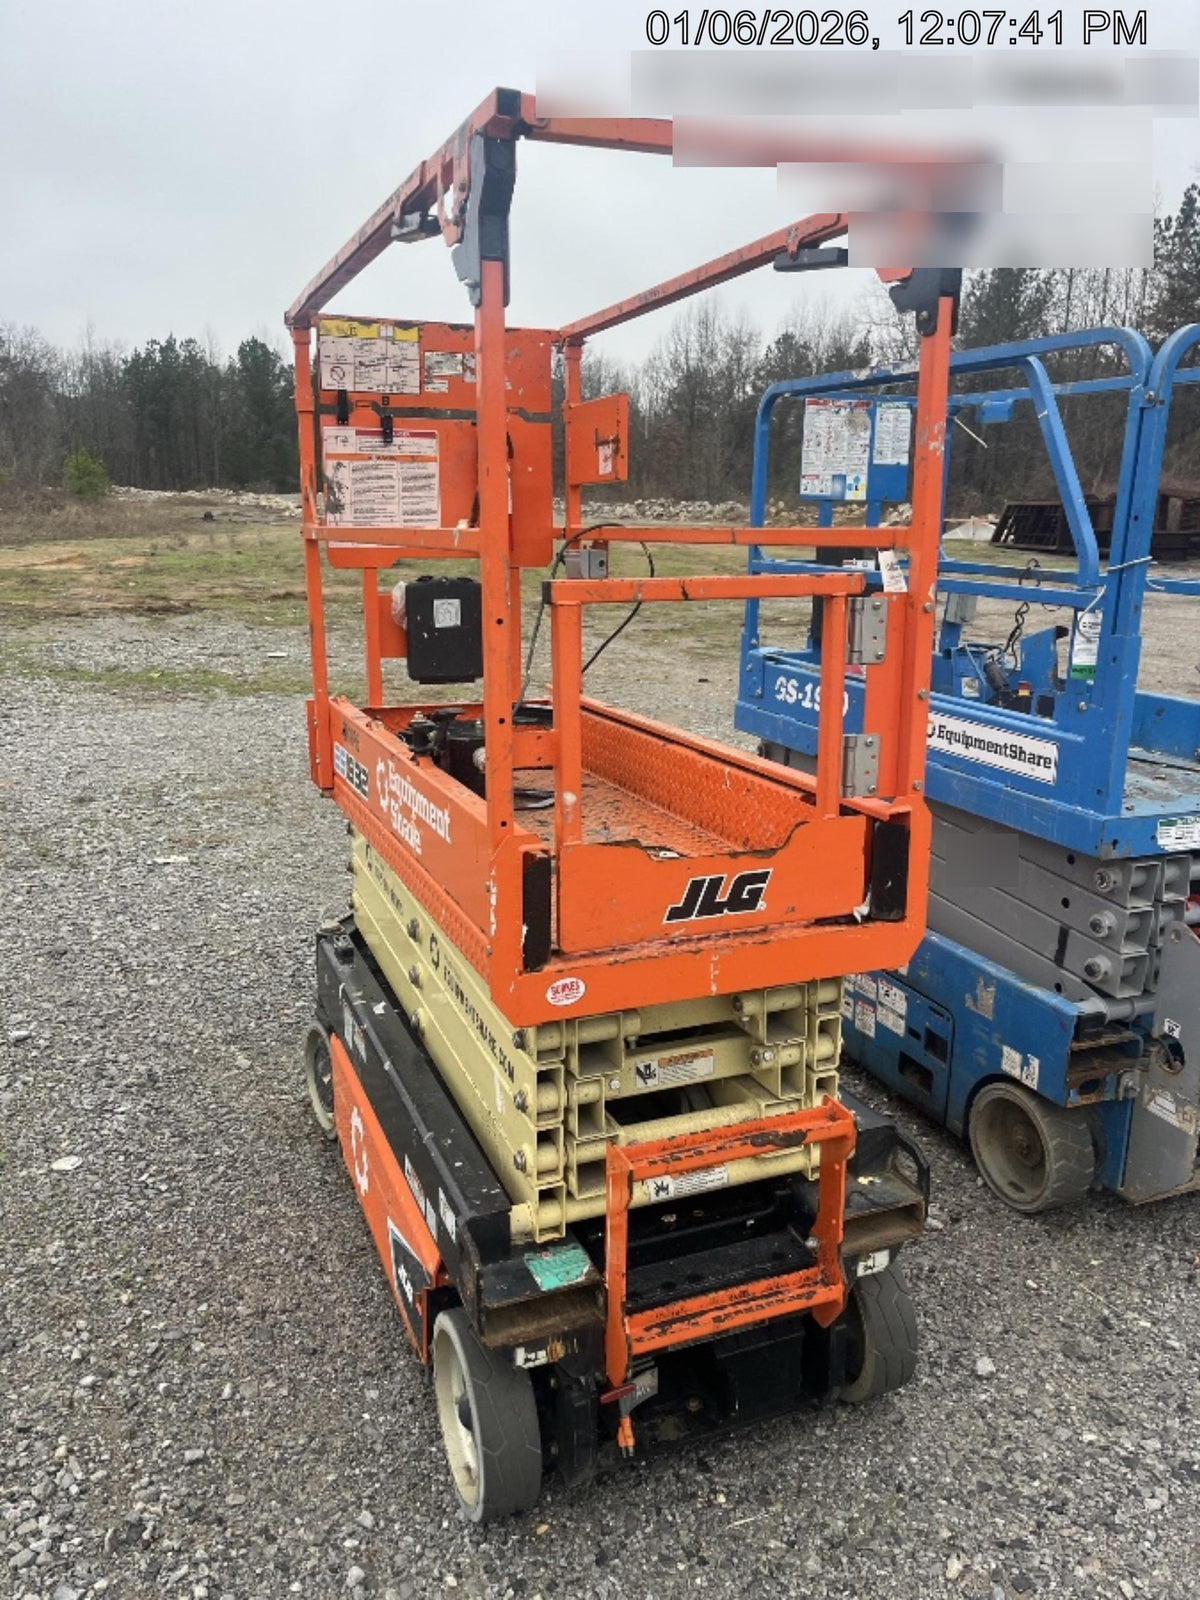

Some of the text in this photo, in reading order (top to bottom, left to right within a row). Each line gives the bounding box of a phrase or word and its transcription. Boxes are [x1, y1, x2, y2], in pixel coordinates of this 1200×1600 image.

[774, 675, 850, 717] GS-19
[937, 724, 1053, 769] EquipmentShare
[387, 758, 452, 845] Equipment
[663, 868, 774, 924] JLG
